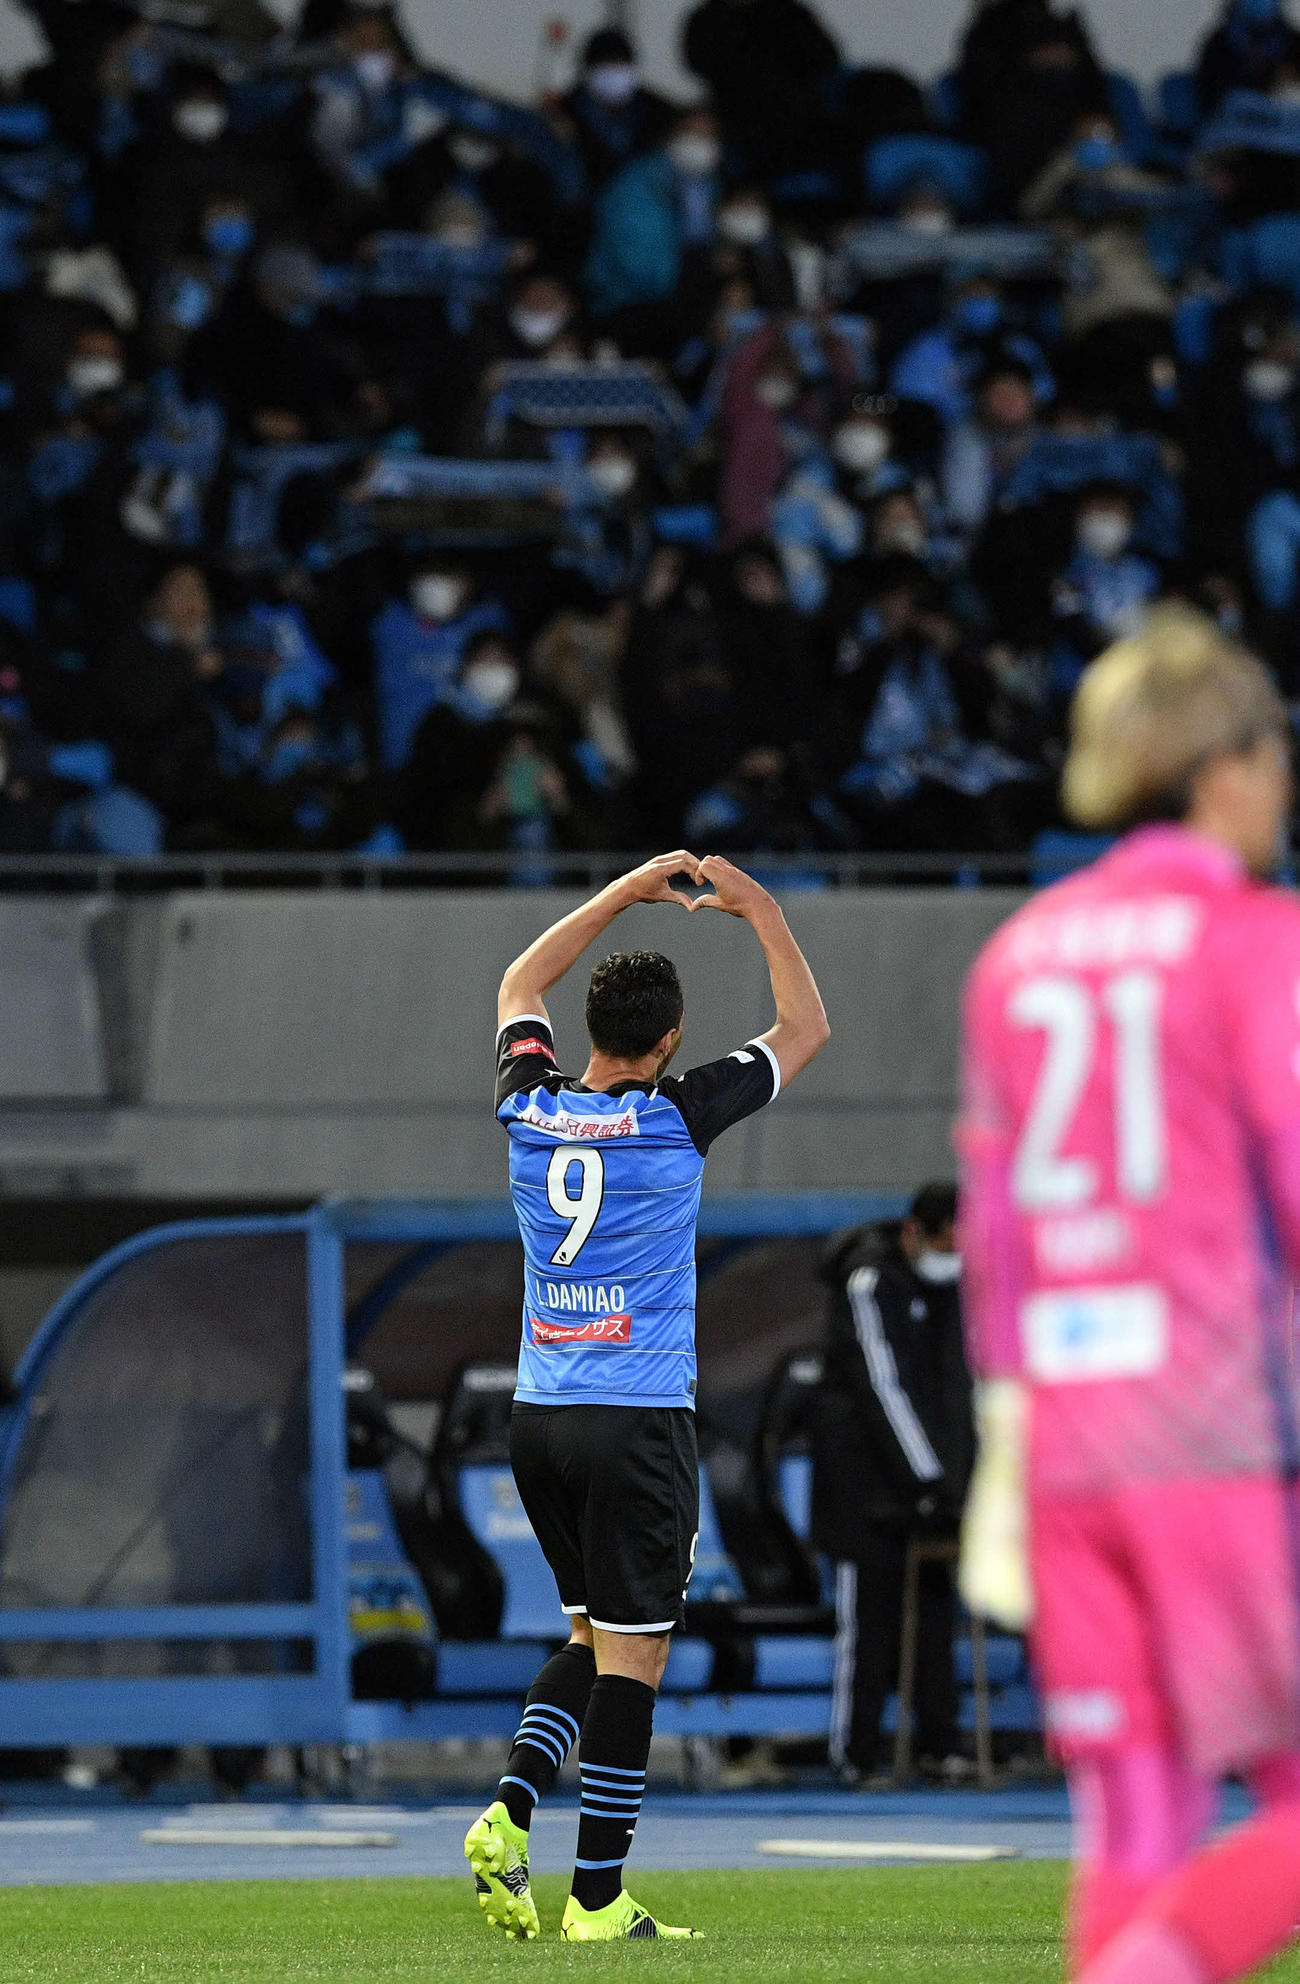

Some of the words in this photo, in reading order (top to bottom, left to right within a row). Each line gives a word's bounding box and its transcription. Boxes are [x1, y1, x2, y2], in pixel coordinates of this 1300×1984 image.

[1008, 970, 1164, 1210] 21
[546, 1144, 605, 1267] 9
[536, 1278, 625, 1313] L.DAMIAO
